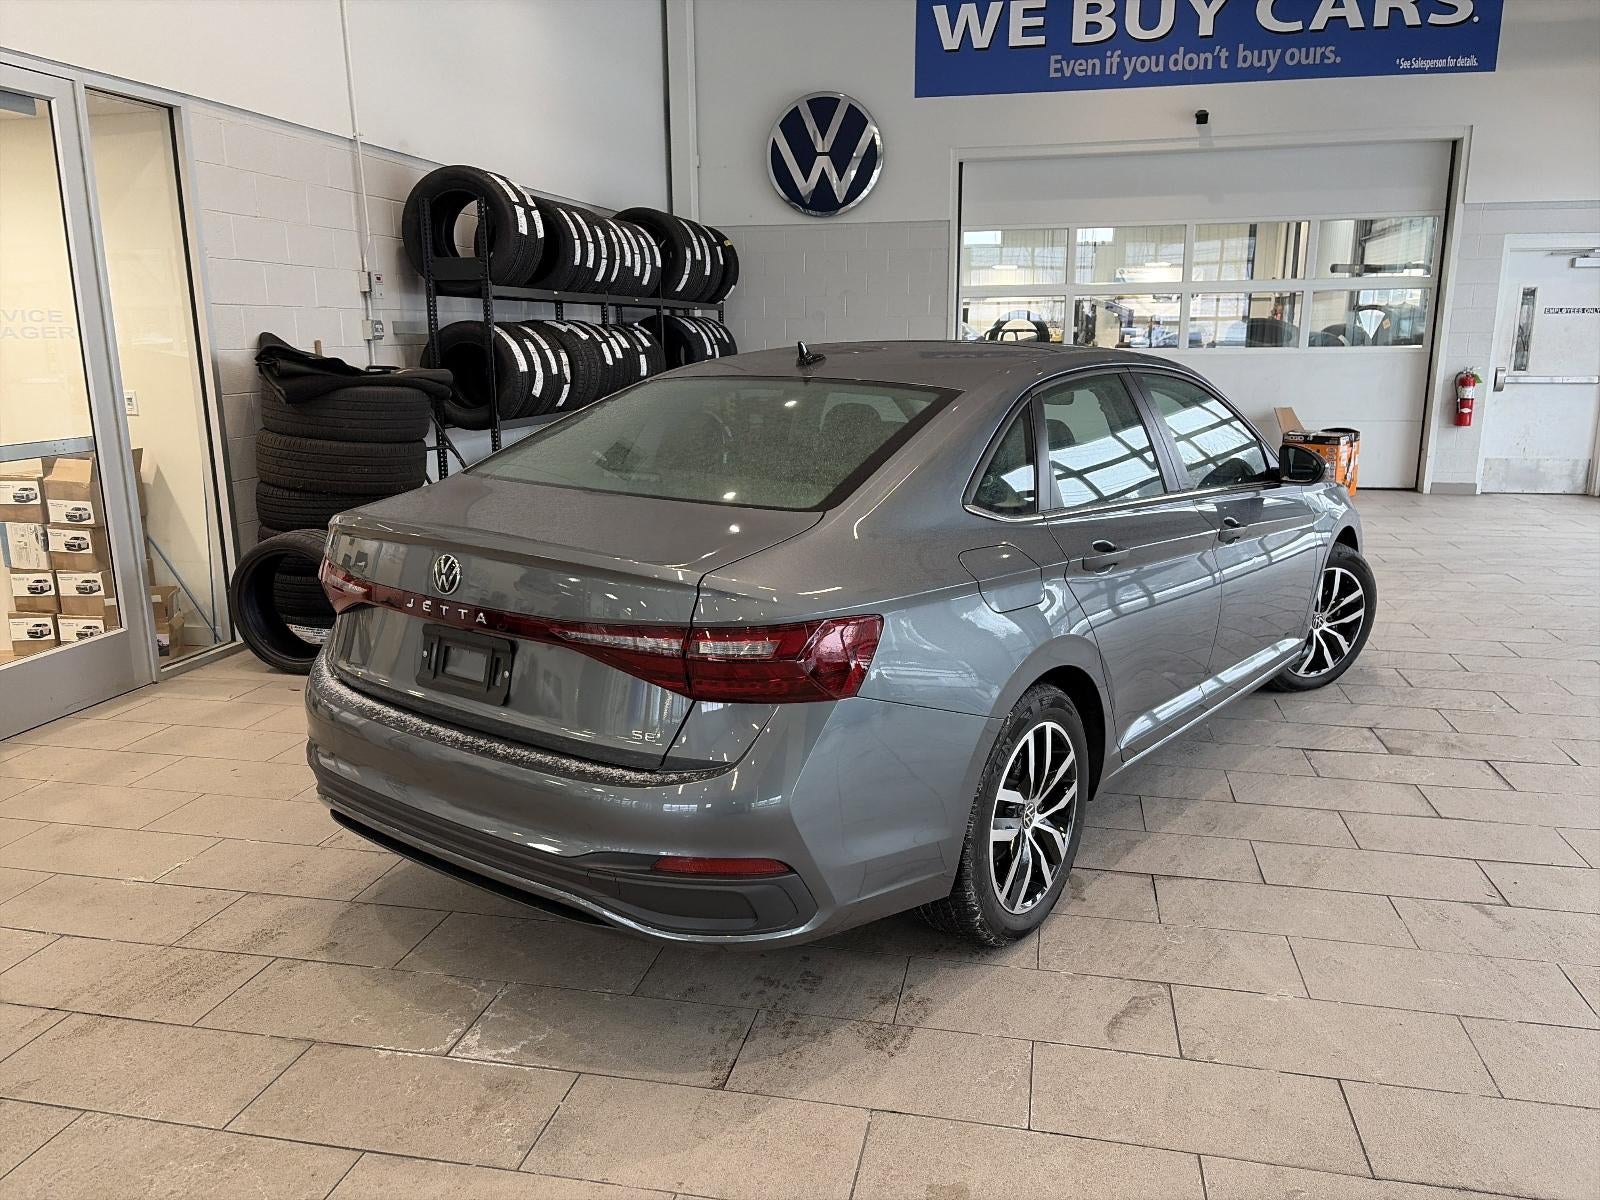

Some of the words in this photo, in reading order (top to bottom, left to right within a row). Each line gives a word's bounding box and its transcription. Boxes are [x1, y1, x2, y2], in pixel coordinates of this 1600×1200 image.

[933, 0, 1046, 51] WE
[1071, 0, 1226, 44] BUY
[1050, 55, 1100, 78] Even
[1105, 50, 1120, 75] if
[1123, 53, 1164, 81] you
[1169, 45, 1229, 72] don't
[1237, 43, 1281, 74] buy
[1285, 44, 1341, 66] ours.
[1411, 57, 1447, 70] Salesperson
[1447, 56, 1456, 67] for
[1457, 55, 1478, 67] details.
[406, 599, 488, 625] JETTA
[632, 730, 656, 742] SE
